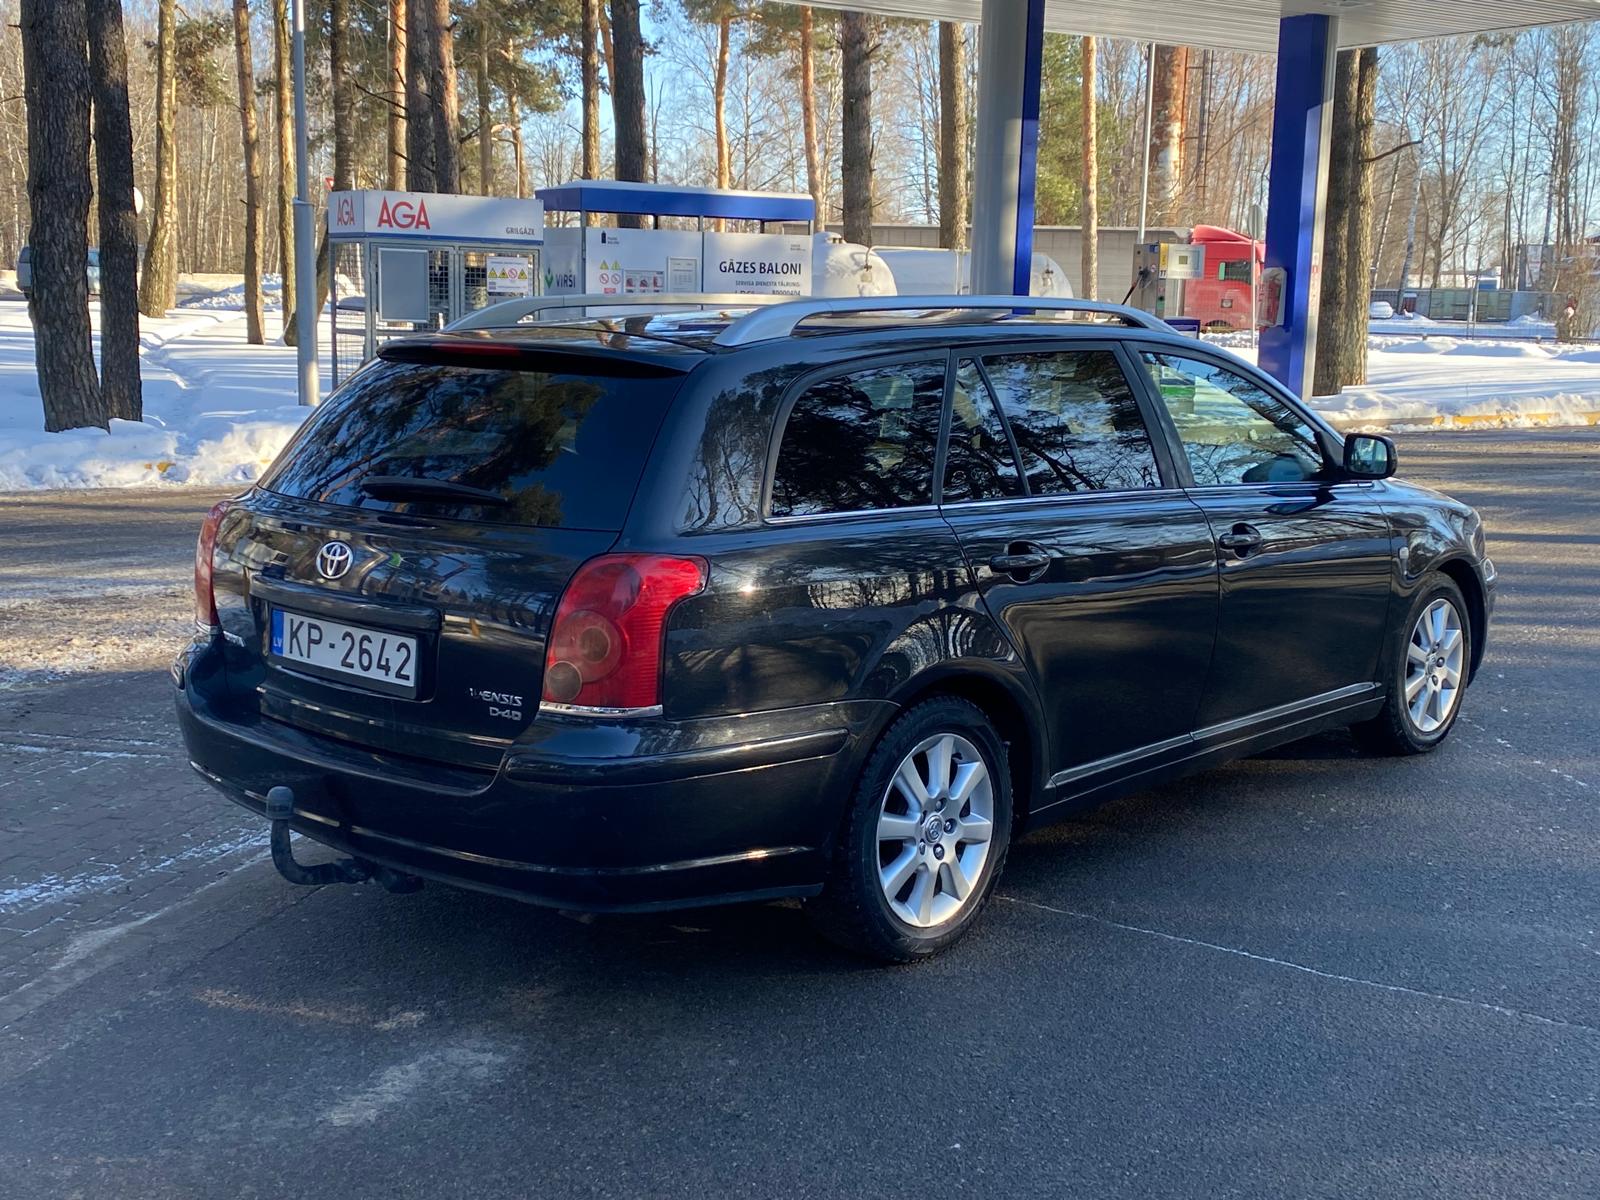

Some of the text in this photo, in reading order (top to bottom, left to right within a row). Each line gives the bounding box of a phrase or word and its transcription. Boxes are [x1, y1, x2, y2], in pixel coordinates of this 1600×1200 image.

[337, 197, 355, 226] AGA
[377, 195, 430, 230] AGA
[719, 259, 801, 275] GĀZES BALONI
[555, 270, 576, 288] VIRŠI
[273, 636, 282, 648] LV
[288, 618, 411, 681] KP-2642
[489, 706, 522, 721] D-4D
